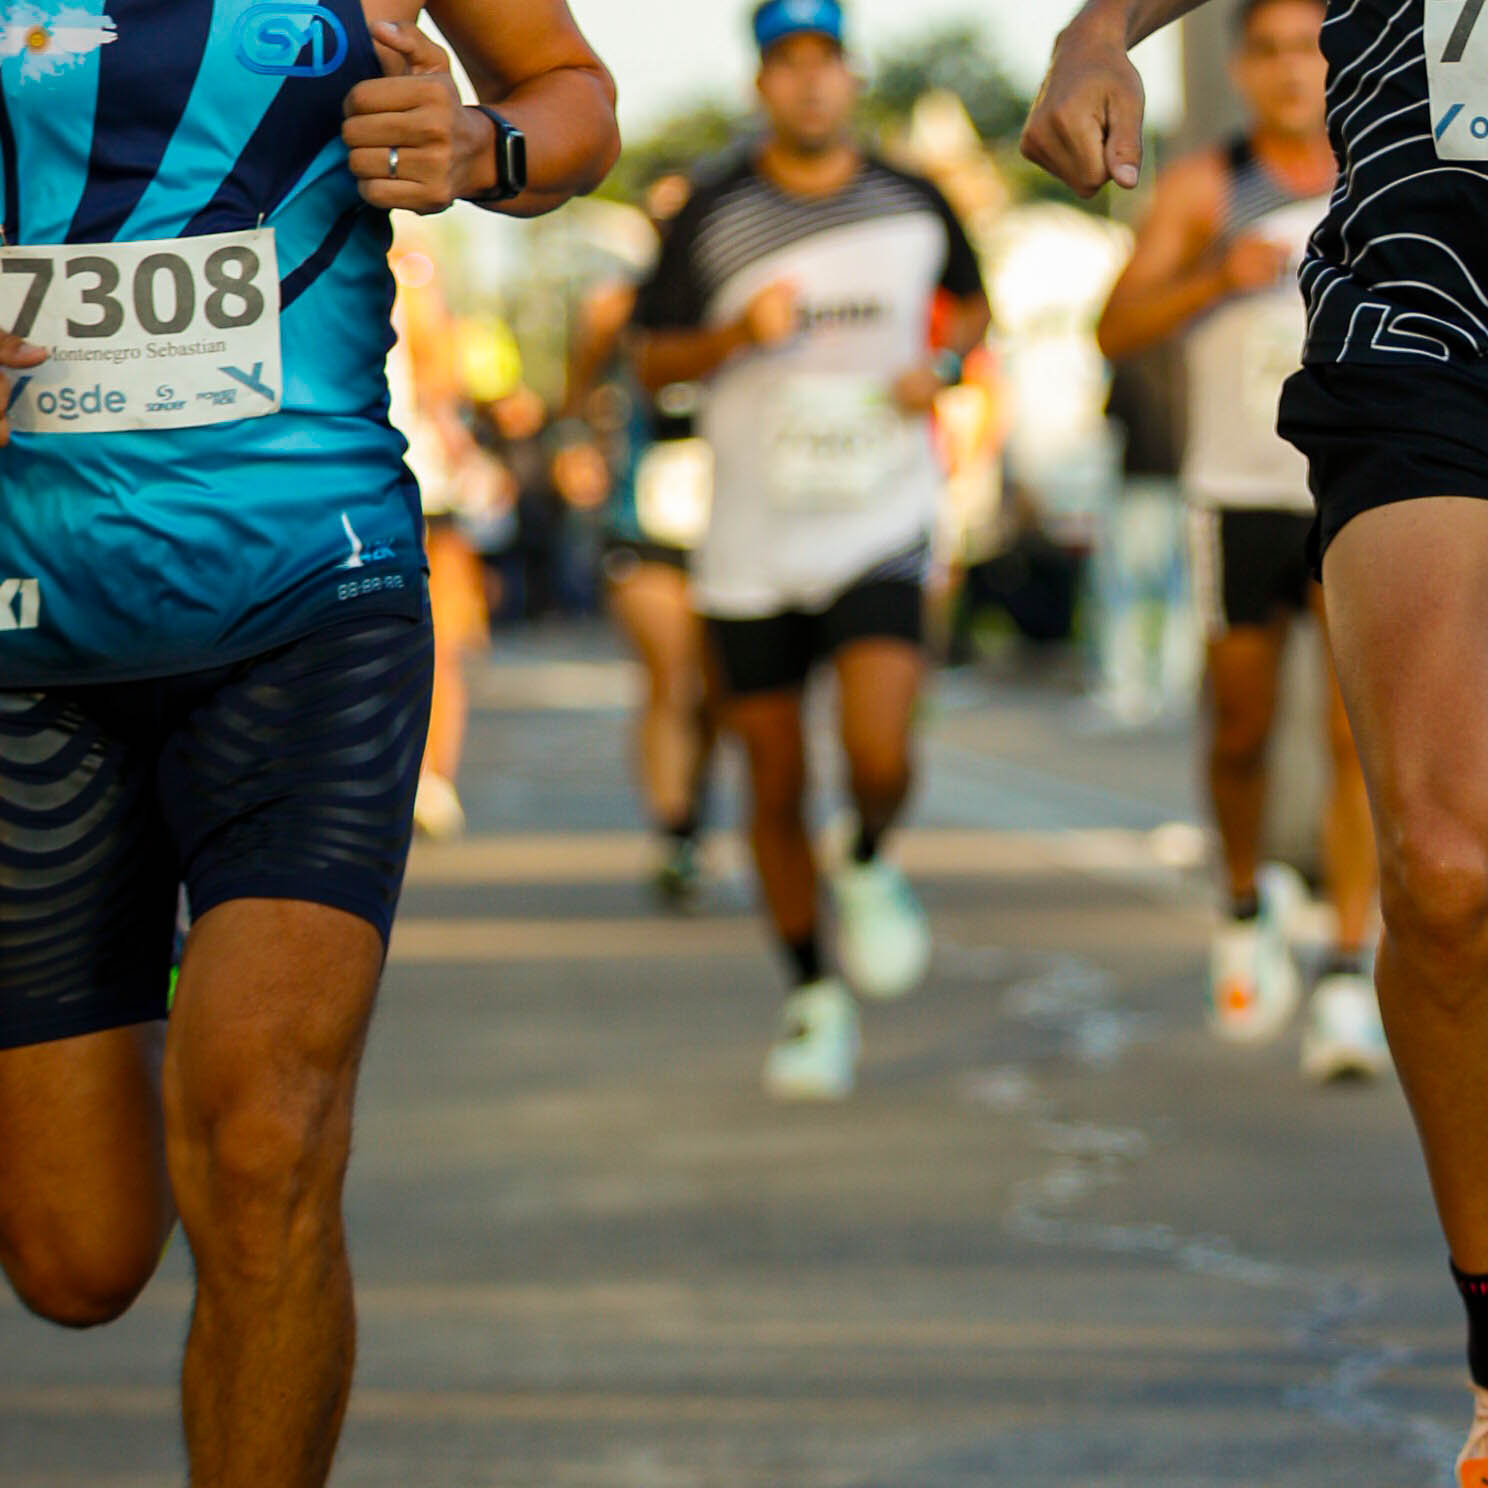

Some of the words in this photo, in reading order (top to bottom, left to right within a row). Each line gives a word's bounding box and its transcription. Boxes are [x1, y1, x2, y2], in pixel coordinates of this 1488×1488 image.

[1, 245, 265, 339] 7308
[146, 339, 227, 359] Sebastian
[37, 384, 126, 419] osde
